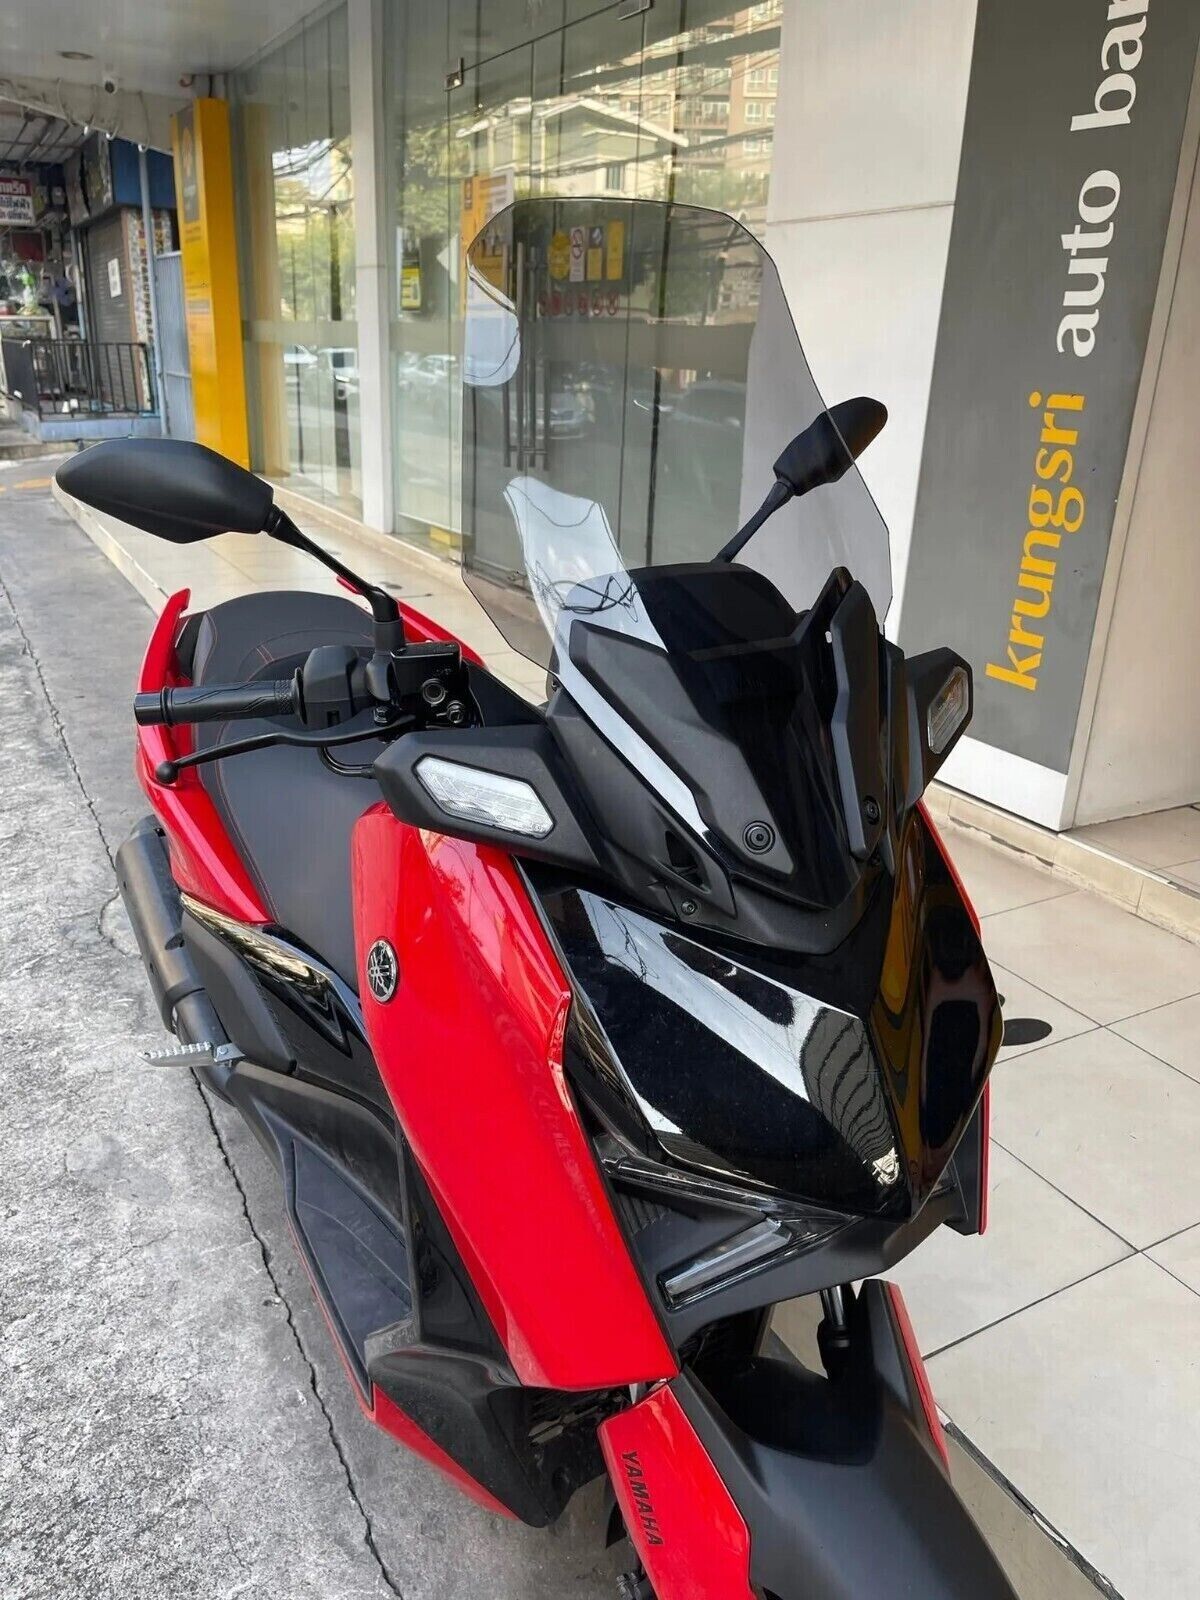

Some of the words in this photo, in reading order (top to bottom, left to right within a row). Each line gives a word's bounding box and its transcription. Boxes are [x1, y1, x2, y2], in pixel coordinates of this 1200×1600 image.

[985, 391, 1085, 690] krungsri
[1056, 170, 1121, 358] auto
[622, 1451, 664, 1545] YAMAHA
